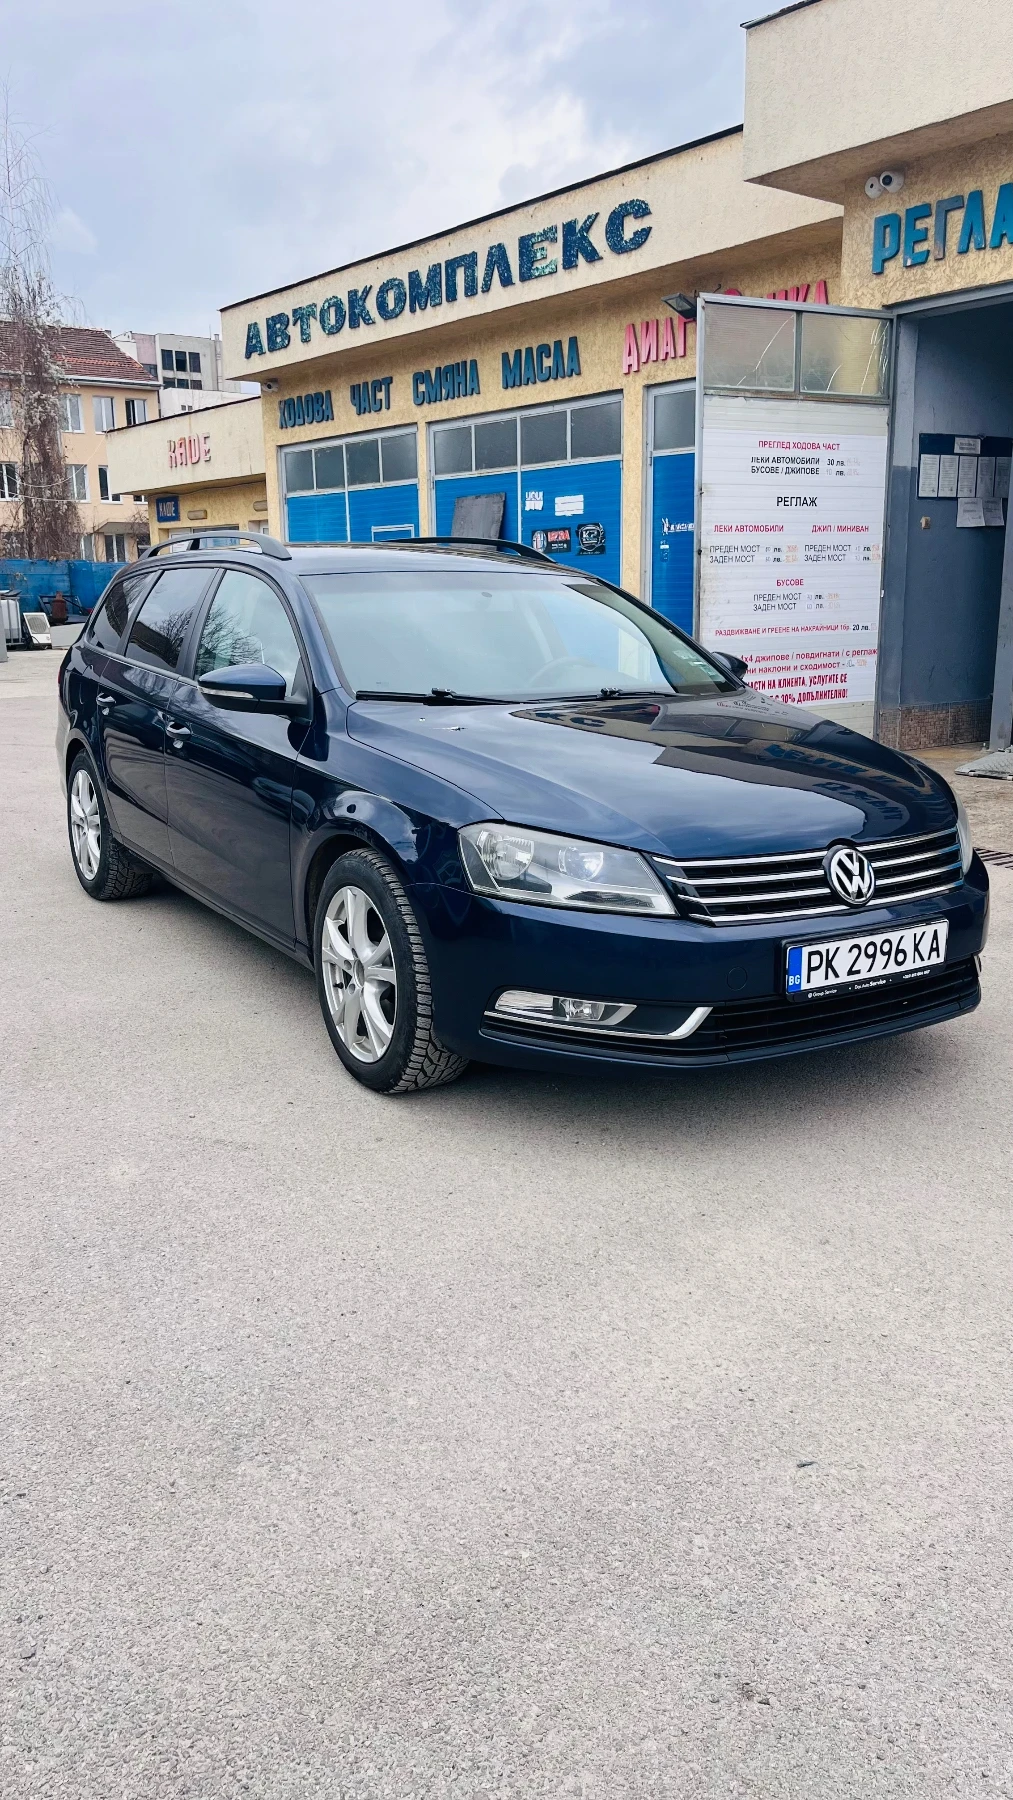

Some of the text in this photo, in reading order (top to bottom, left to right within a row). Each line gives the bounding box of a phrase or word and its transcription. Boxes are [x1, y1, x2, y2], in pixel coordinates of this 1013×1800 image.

[245, 198, 653, 359] АВТОКОМПЛЕКС
[278, 336, 581, 429] ХОДОВА ЧАСТ СМЯНА МАСЛА
[758, 440, 840, 451] ПРЕГЛЕД ХОДОВА ЧАСТ
[751, 456, 770, 464] ЛЕКИ
[771, 457, 820, 465] АВТОМОБИЛИ
[827, 458, 834, 466] 30
[751, 465, 779, 474] БУСОВЕ
[784, 466, 819, 475] ДЖИПОВЕ
[776, 496, 818, 507] РЕГЛАЖ
[713, 524, 784, 533] ЛЕКИ АВТОМОБИЛИ
[811, 524, 832, 533] ДЖИП
[836, 525, 869, 533] МИНИВАН
[709, 545, 739, 554] ПРЕДЕН
[740, 544, 760, 553] МОСТ
[804, 544, 832, 553] ПРЕДЕН
[832, 544, 851, 552] МОСТ
[709, 555, 734, 564] ЗАДЕН
[734, 555, 755, 563] МОСТ
[804, 554, 826, 563] ЗАДЕН
[827, 554, 846, 562] МОСТ
[776, 578, 804, 587] БУСОВЕ
[753, 593, 781, 602] ПРЕДЕН
[782, 592, 802, 601] МОСТ
[753, 603, 776, 612] ЗАДЕН
[777, 602, 797, 611] МОСТ
[715, 627, 761, 637] РАЗДВИЖВАНЕ
[767, 626, 790, 634] ГРЕЕНЕ
[852, 623, 860, 631] 20
[755, 654, 790, 663] джипове
[795, 651, 840, 659] повдигнати
[758, 665, 791, 673] наклони
[799, 662, 841, 671] сходимост
[767, 679, 776, 690] НА
[808, 674, 839, 687] УСЛУГИТЕ
[840, 673, 848, 683] СЕ
[796, 688, 848, 704] ДОПЪЛНИТЕЛНО!
[806, 929, 941, 984] PK 2996 KA
[788, 975, 801, 986] BG
